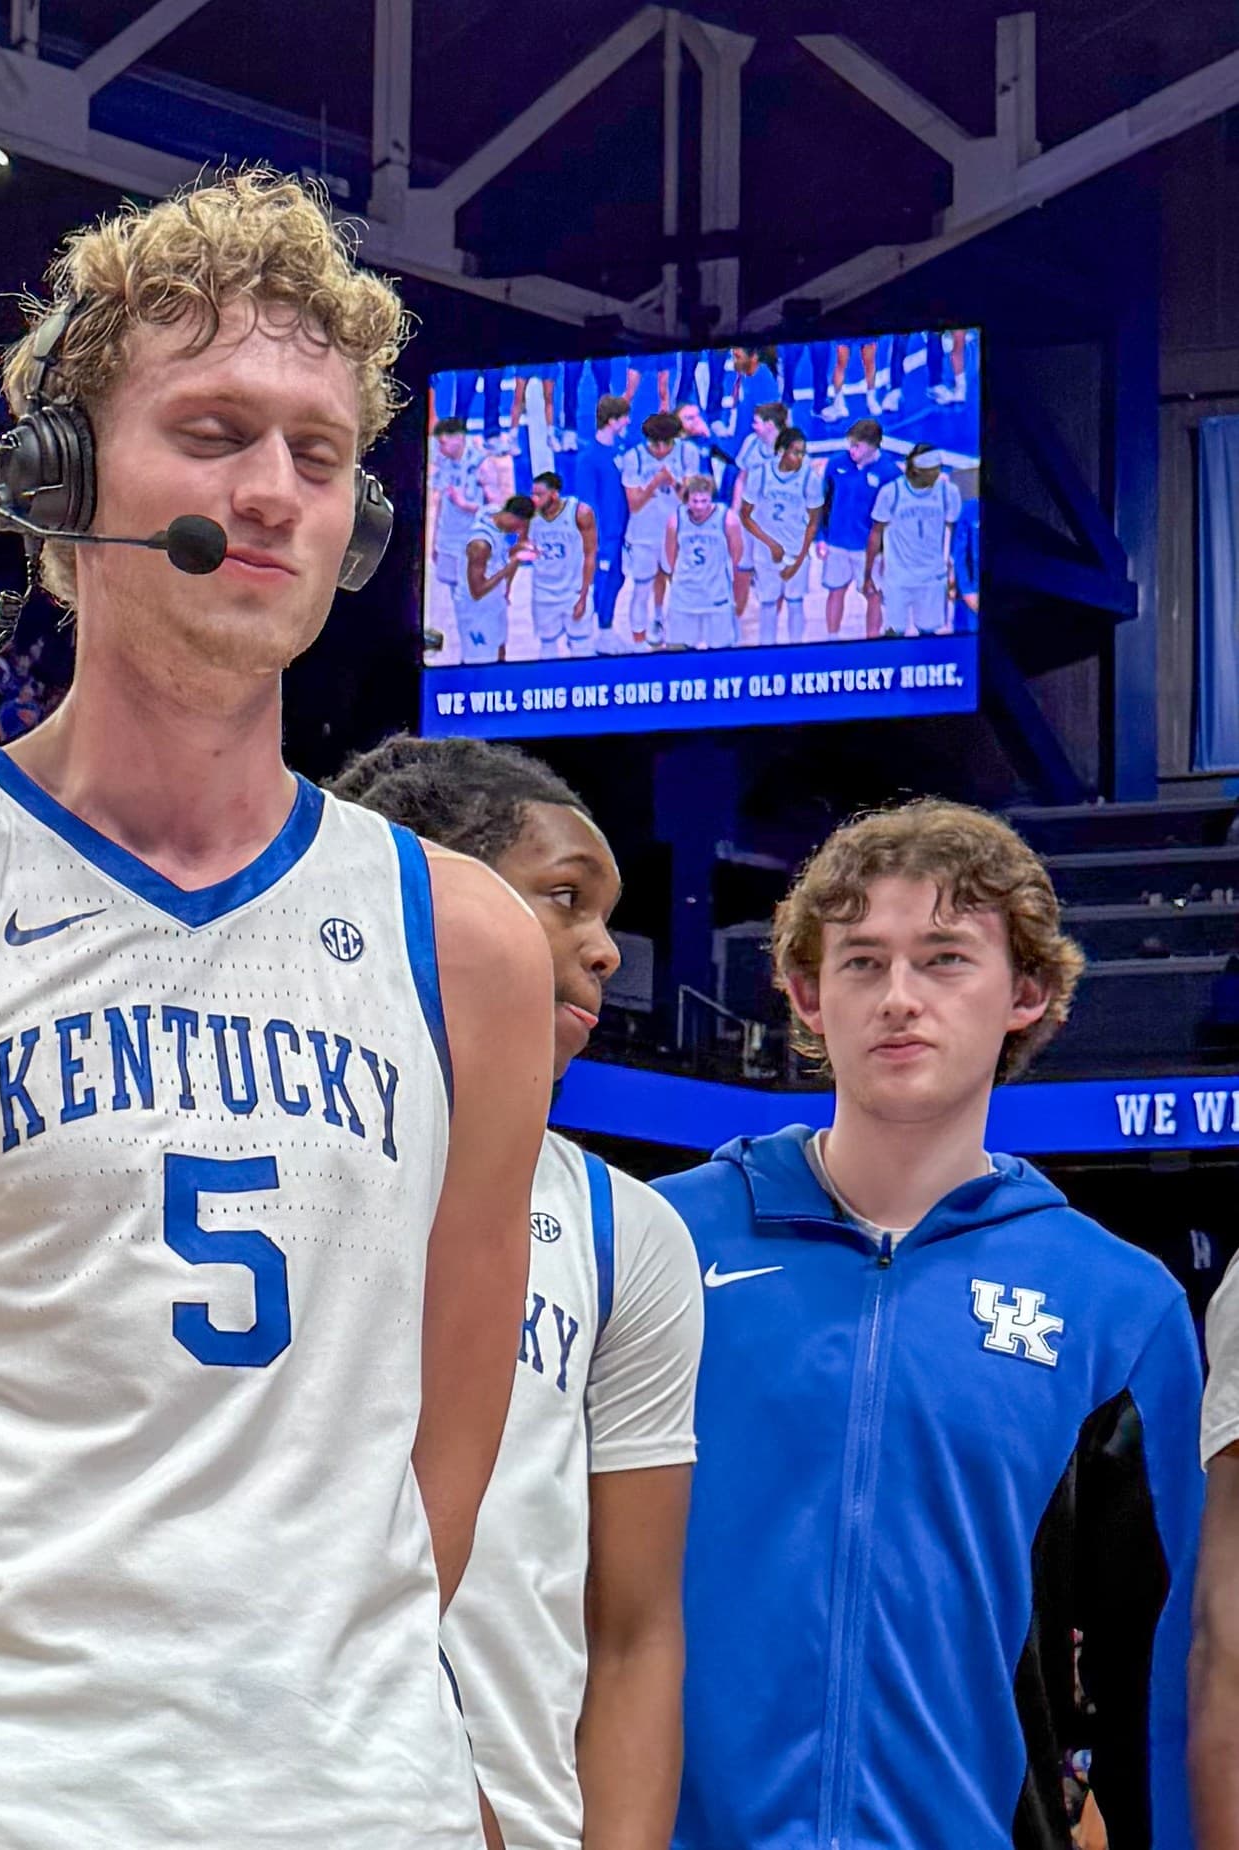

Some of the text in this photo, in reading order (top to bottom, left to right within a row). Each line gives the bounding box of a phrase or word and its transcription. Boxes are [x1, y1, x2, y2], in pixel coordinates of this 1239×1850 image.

[436, 692, 465, 715] WE
[469, 690, 517, 713] WILL
[522, 687, 567, 711] SING
[572, 685, 609, 708] ONE
[614, 682, 663, 705] SONG
[669, 679, 707, 702] FOR
[713, 677, 744, 699] MY
[749, 674, 786, 697] OLD
[790, 667, 895, 695] KENTUCKY
[321, 919, 364, 961] SEC
[1115, 1092, 1177, 1136] WE
[163, 1152, 293, 1369] 5
[970, 1279, 1065, 1367] UK
